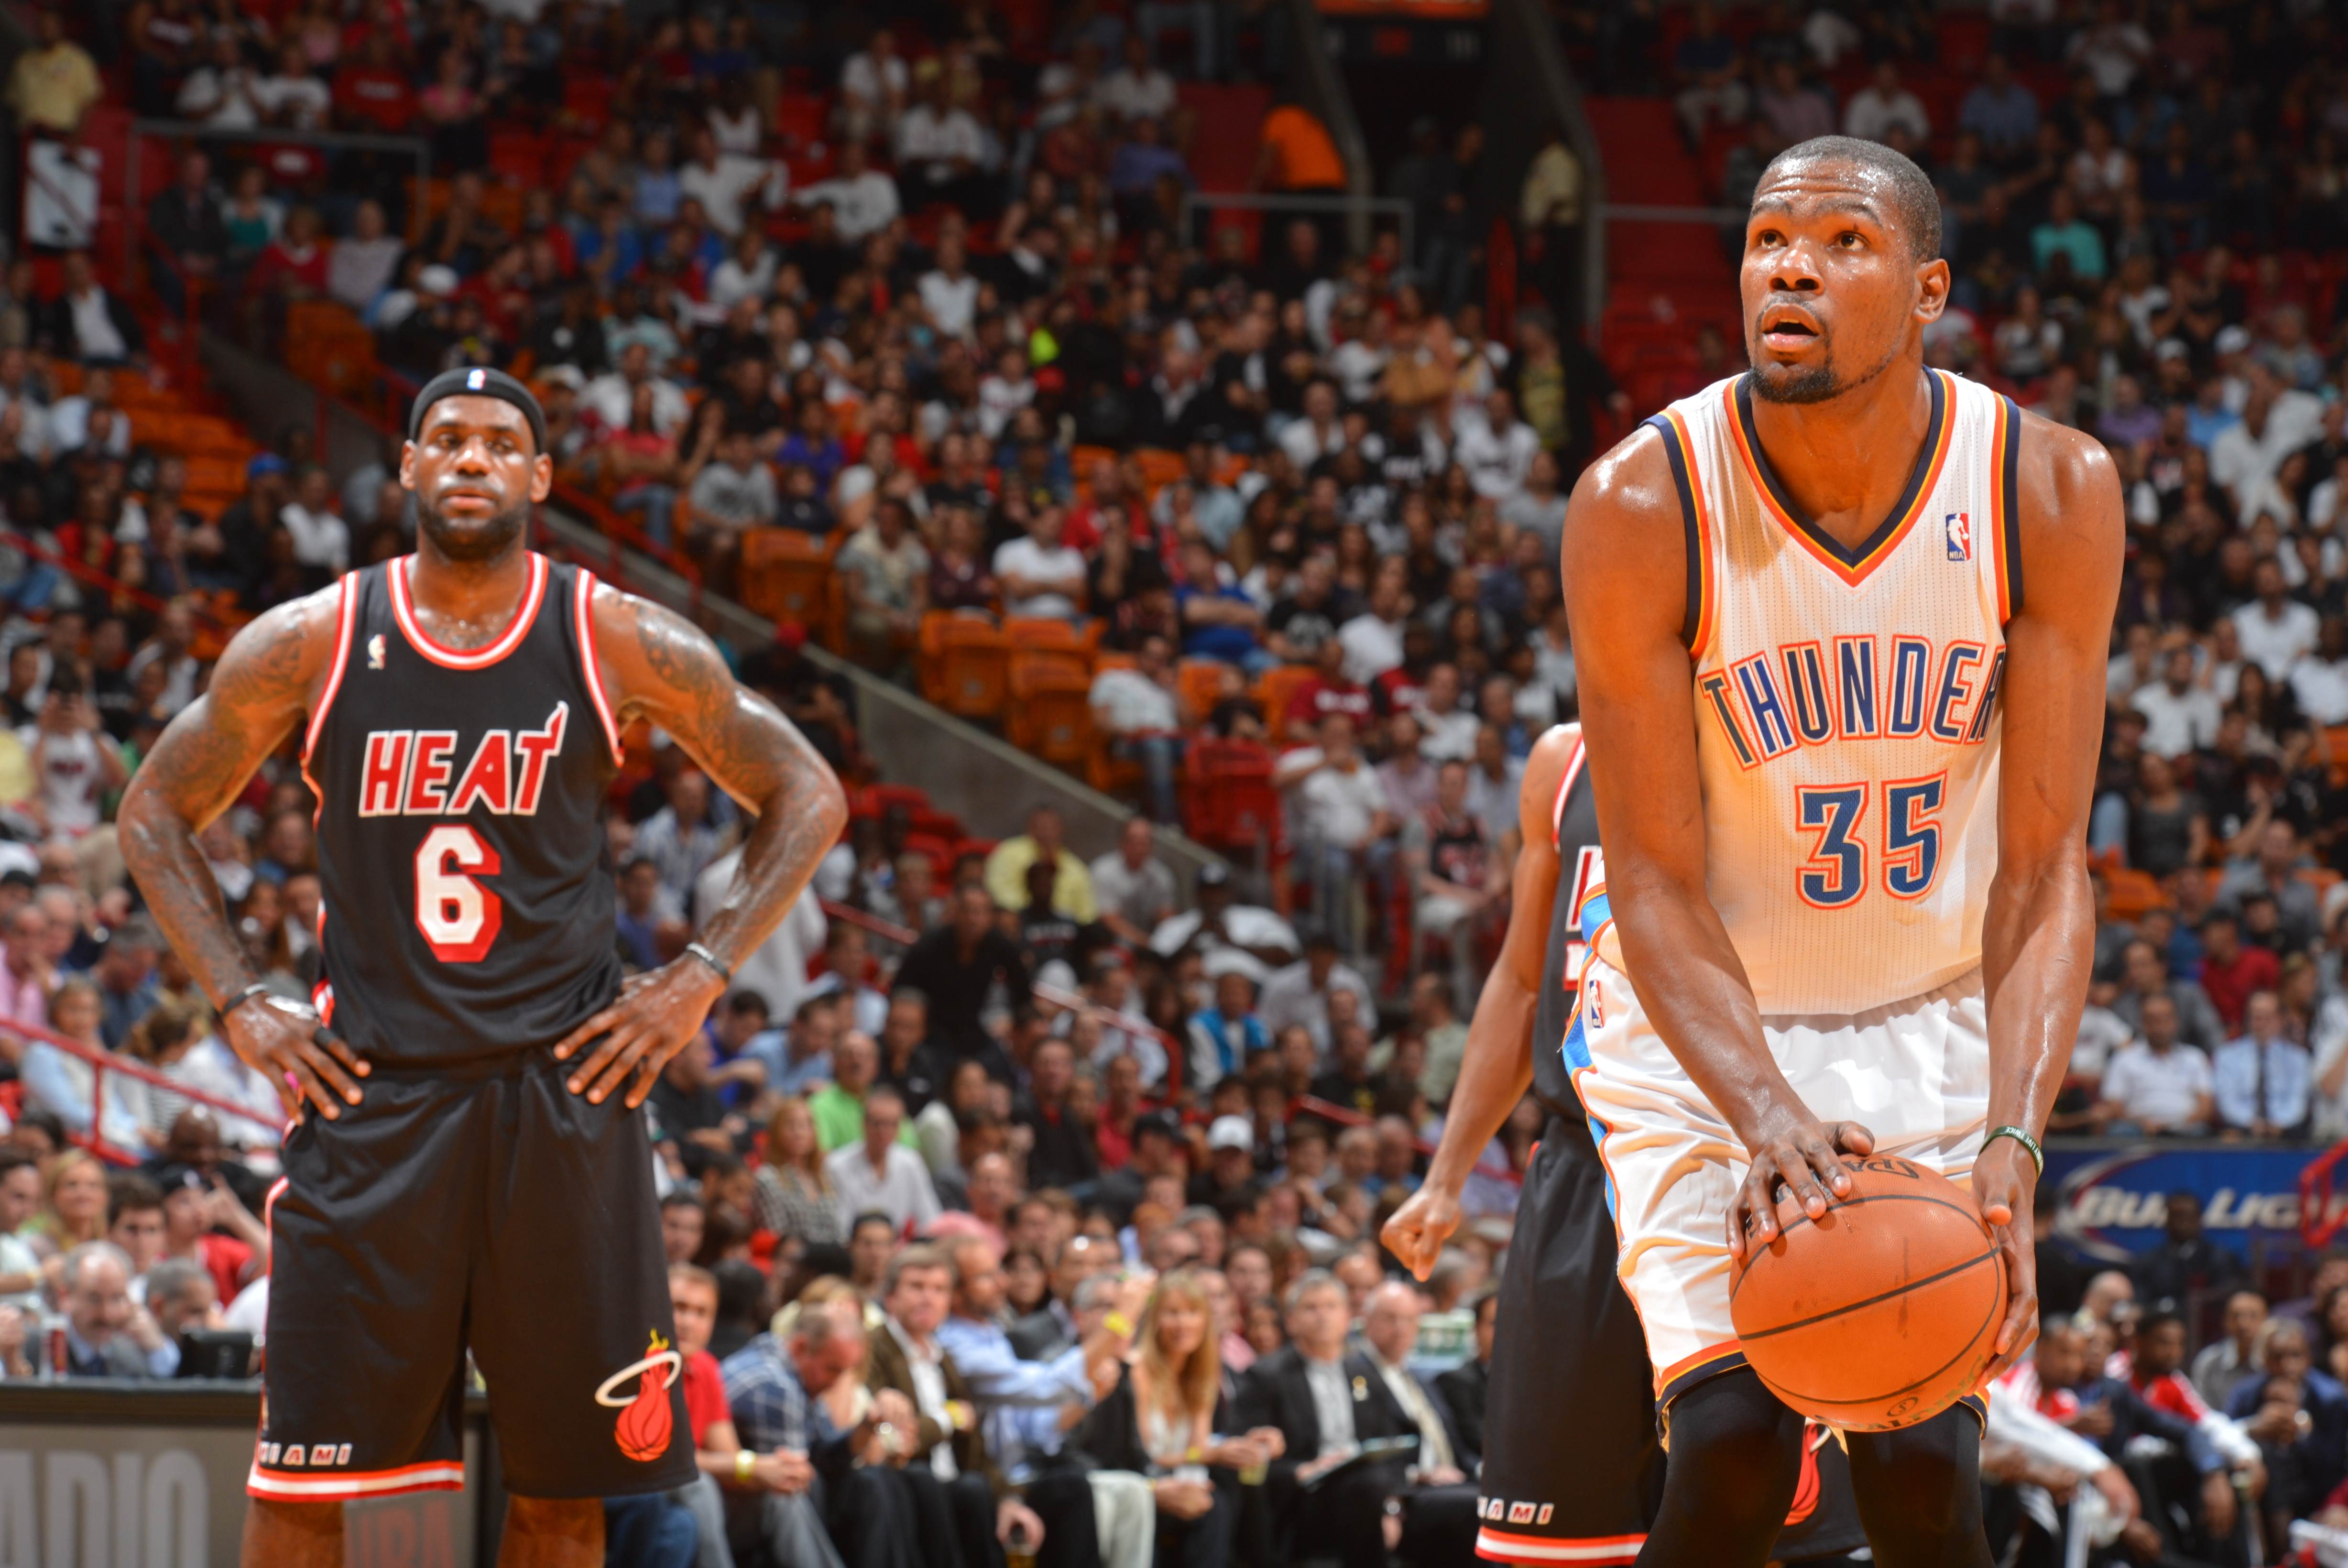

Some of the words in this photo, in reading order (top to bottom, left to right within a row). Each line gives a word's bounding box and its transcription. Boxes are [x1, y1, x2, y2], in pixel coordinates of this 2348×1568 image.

[1949, 551, 1964, 560] NBA
[1698, 634, 2006, 771] THUNDER
[359, 700, 569, 817] HEAT
[1794, 769, 1948, 910] 35
[413, 823, 502, 963] 6
[2004, 1126, 2025, 1140] TWICE
[2024, 1135, 2037, 1151] LIVE
[2075, 1185, 2169, 1228] BU
